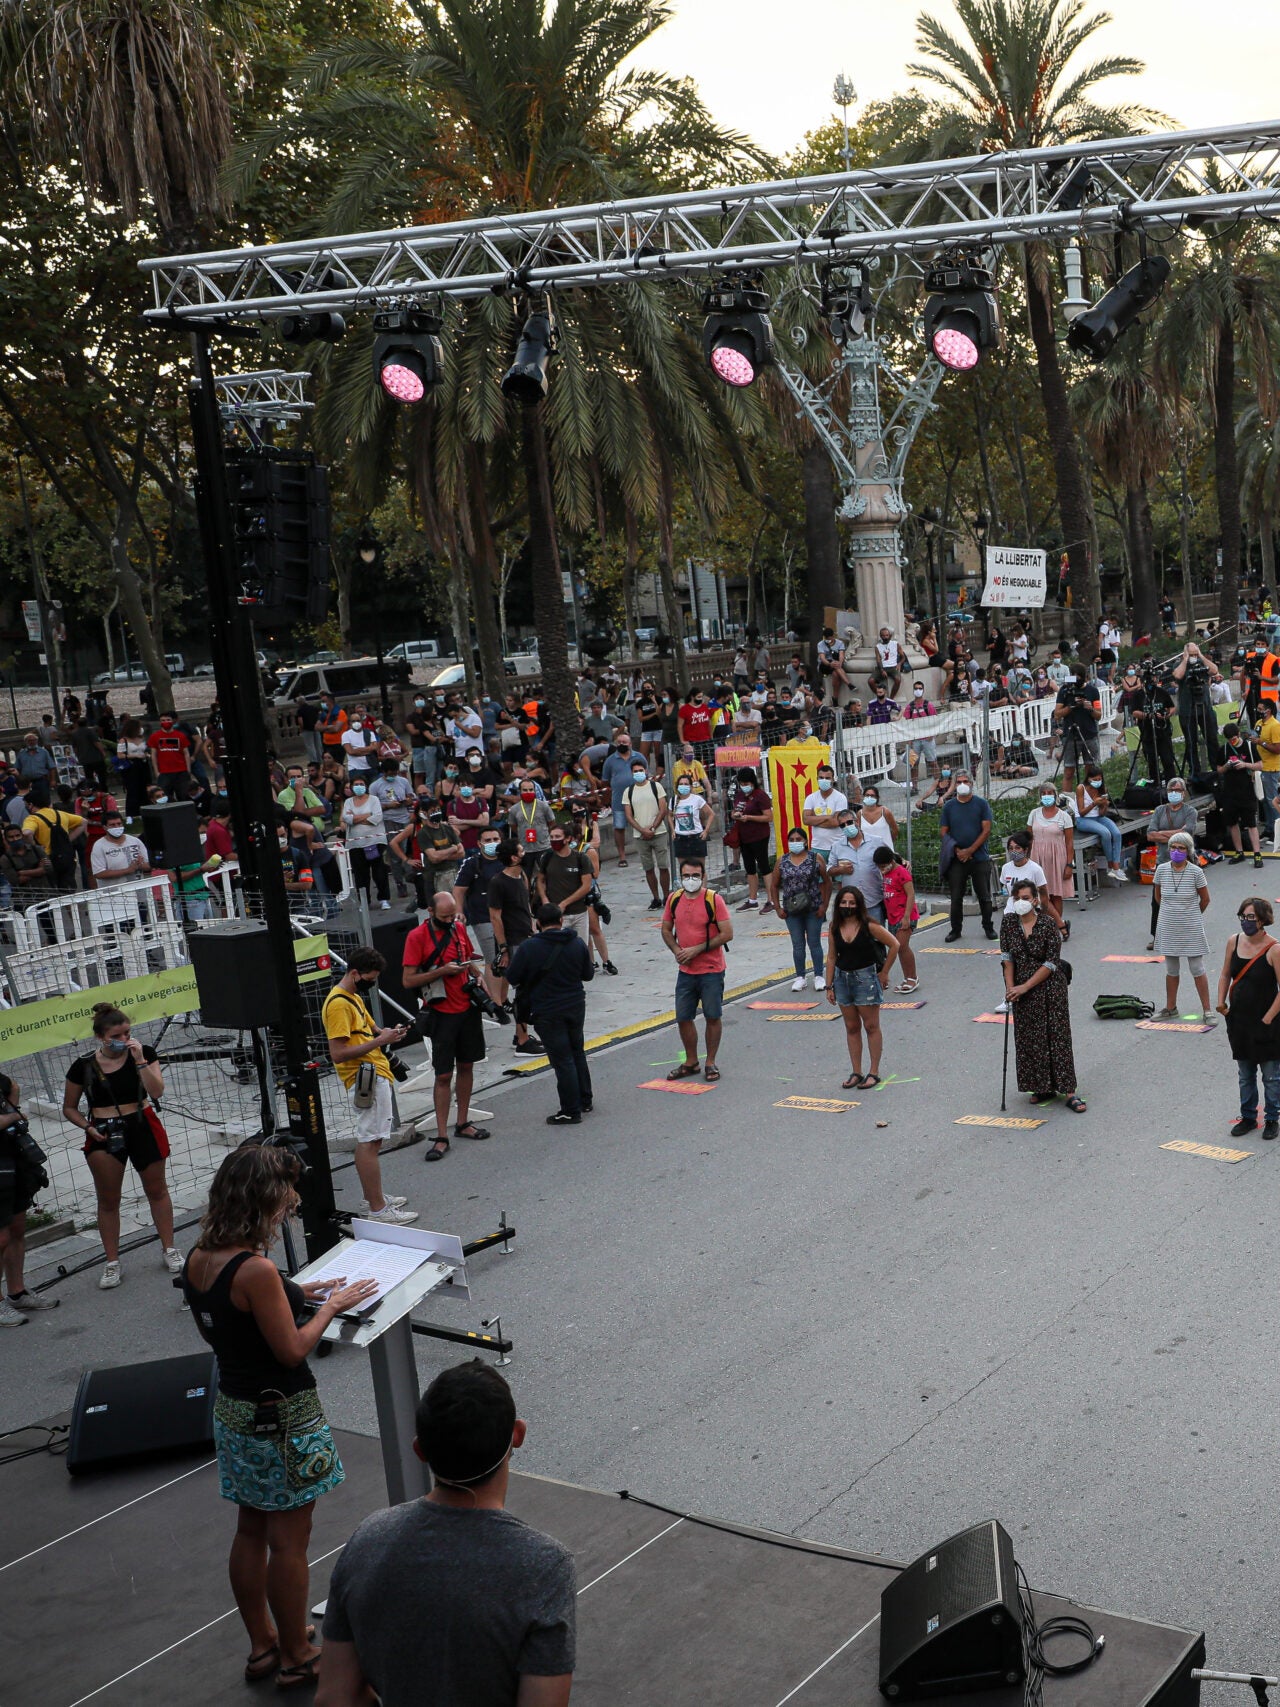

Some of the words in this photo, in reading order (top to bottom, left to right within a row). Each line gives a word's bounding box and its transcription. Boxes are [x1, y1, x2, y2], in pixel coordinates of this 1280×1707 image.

[994, 552, 1004, 565] LA
[1006, 553, 1042, 567] LLIBERTAT
[993, 575, 1002, 586] NO
[1010, 577, 1042, 589] NEGOCIABLE
[16, 1017, 52, 1034] durant
[52, 1001, 120, 1024] l'arrelat
[120, 996, 135, 1007] de
[136, 994, 147, 1004] la
[148, 981, 198, 1000] vegetació
[953, 1114, 1048, 1130] ECOLOGISME
[1157, 1139, 1256, 1162] ECOLOGISME
